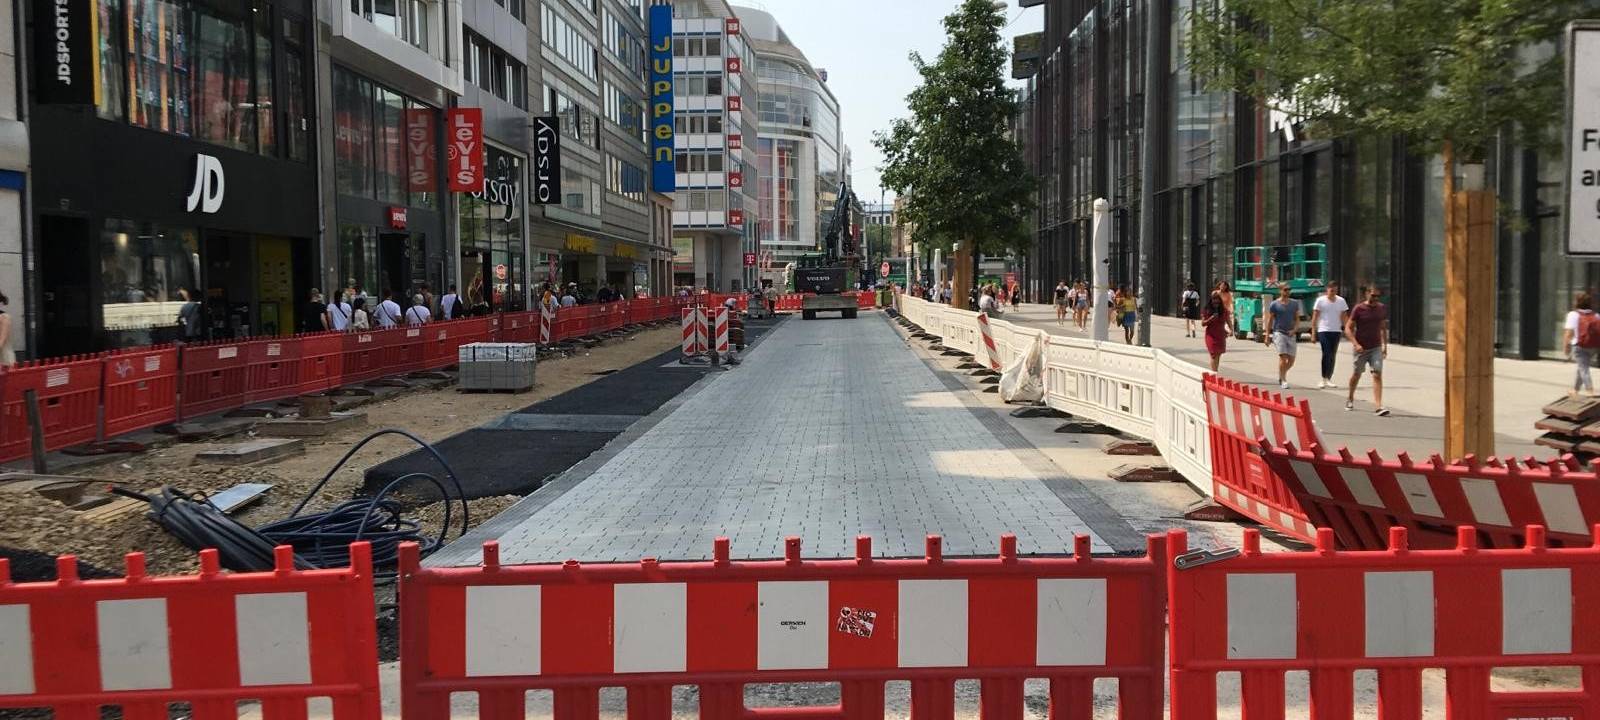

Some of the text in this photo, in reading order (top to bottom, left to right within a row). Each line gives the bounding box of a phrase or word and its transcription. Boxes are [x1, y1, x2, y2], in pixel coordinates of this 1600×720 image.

[653, 36, 673, 161] Juppen
[537, 118, 557, 202] orsay
[1582, 128, 1600, 152] F
[187, 152, 225, 214] JD
